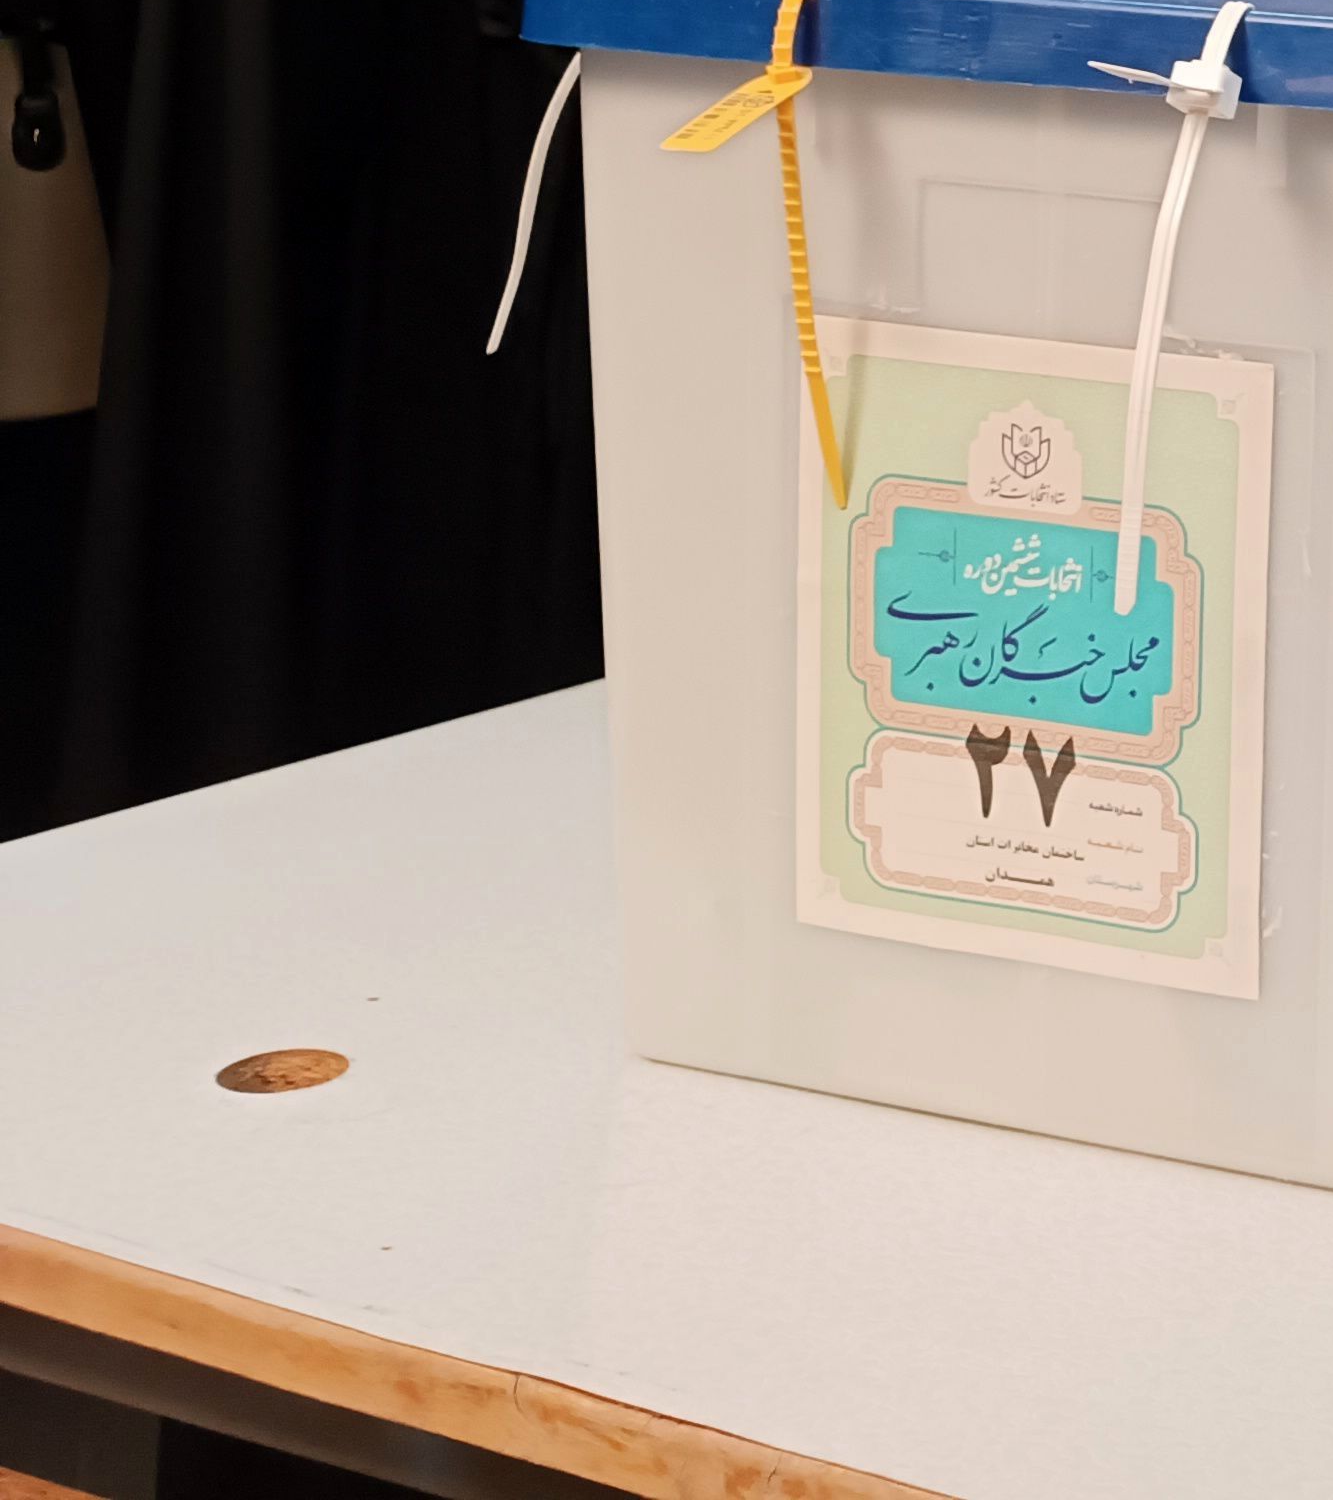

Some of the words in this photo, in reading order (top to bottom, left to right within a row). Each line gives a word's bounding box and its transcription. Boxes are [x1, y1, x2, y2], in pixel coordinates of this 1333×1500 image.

[963, 553, 1002, 579] دوره
[981, 533, 1042, 597] ششمین
[1013, 557, 1083, 601] انتخابات
[886, 590, 979, 692] رهبری
[958, 602, 1106, 705] خبرگان
[1079, 635, 1160, 705] مجلس
[965, 722, 1077, 828] ۲۷
